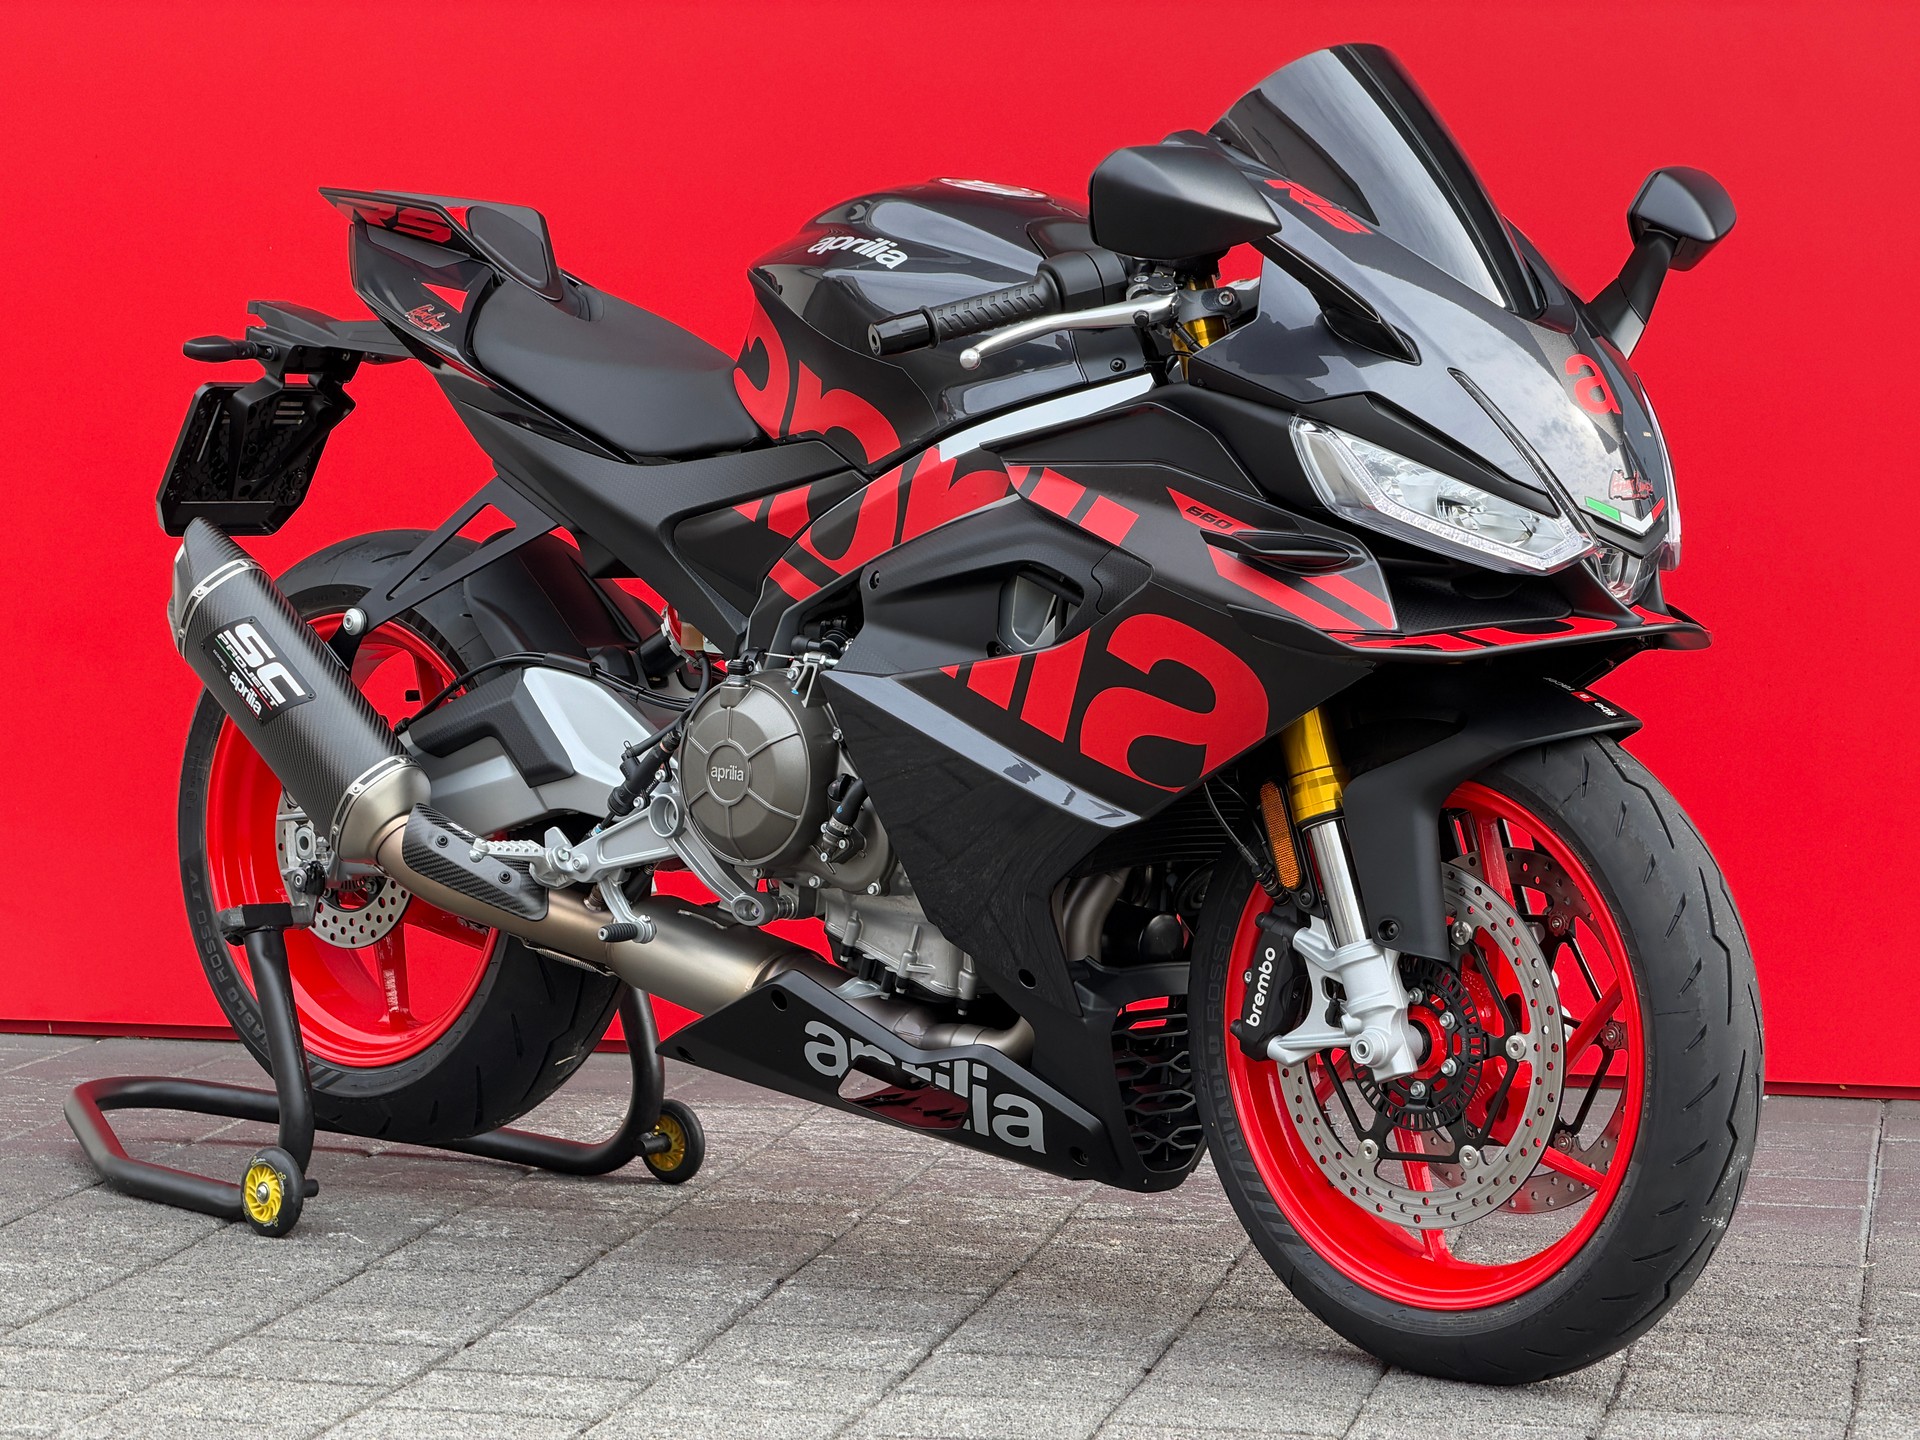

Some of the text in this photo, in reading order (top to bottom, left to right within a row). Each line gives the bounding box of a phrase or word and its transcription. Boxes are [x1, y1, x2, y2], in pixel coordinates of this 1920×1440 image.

[807, 235, 908, 270] aprilia
[1565, 353, 1622, 415] a
[1186, 505, 1233, 530] 660
[217, 632, 279, 707] PROJECT
[222, 622, 306, 704] SC
[229, 670, 262, 716] aprilia
[710, 765, 744, 782] aprilia
[196, 910, 229, 983] ROSSO
[1207, 924, 1231, 1022] ROSSO
[226, 988, 269, 1048] IABLO
[1246, 947, 1276, 1027] brembo
[804, 1020, 1047, 1155] alia
